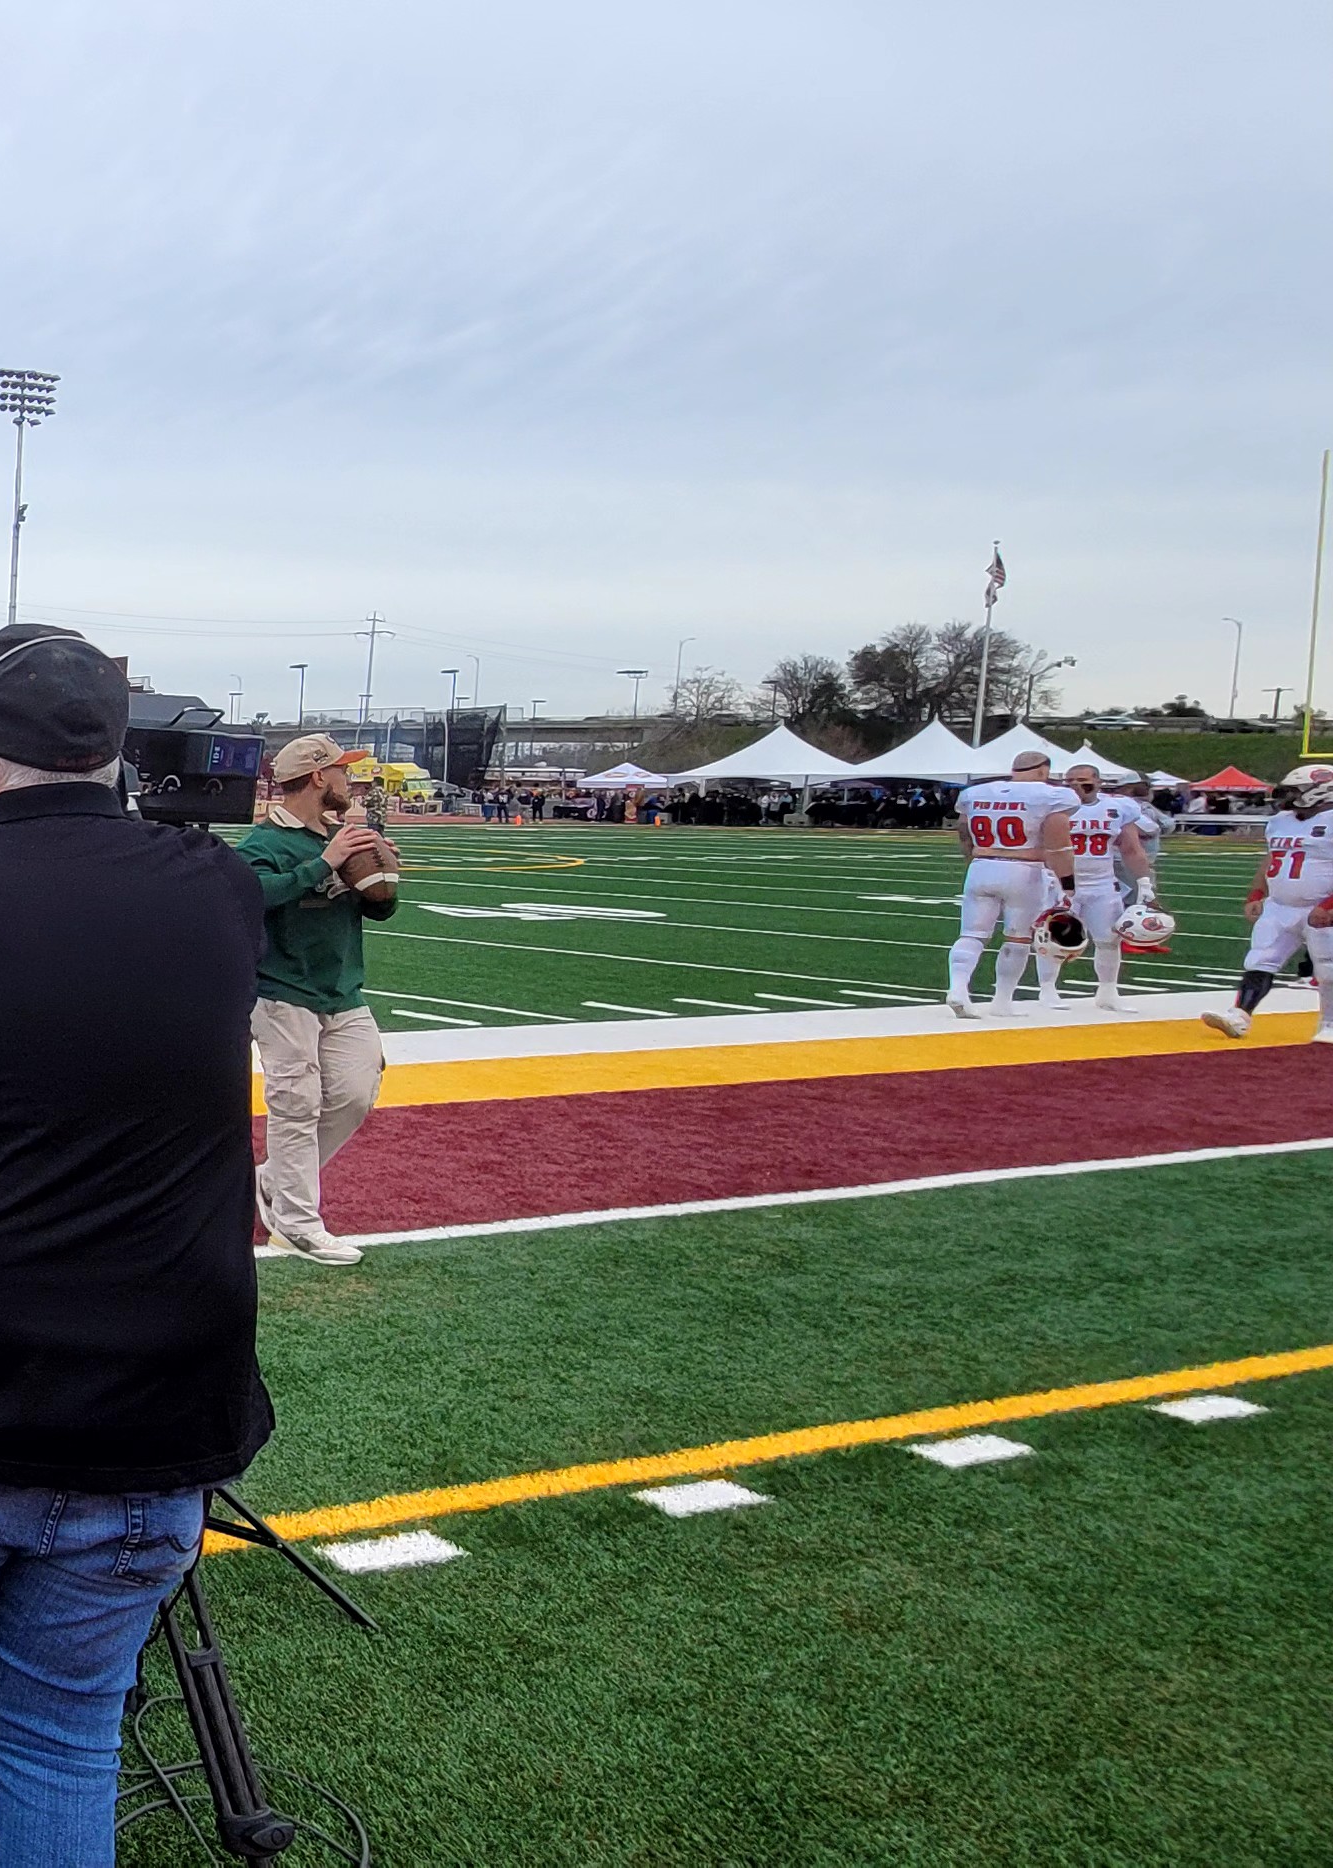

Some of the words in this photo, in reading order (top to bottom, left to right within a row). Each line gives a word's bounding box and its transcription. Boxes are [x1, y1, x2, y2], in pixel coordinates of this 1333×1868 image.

[971, 816, 1027, 847] 90
[1069, 820, 1111, 831] FIRE
[1270, 837, 1304, 849] FIRE
[1266, 851, 1306, 879] 51
